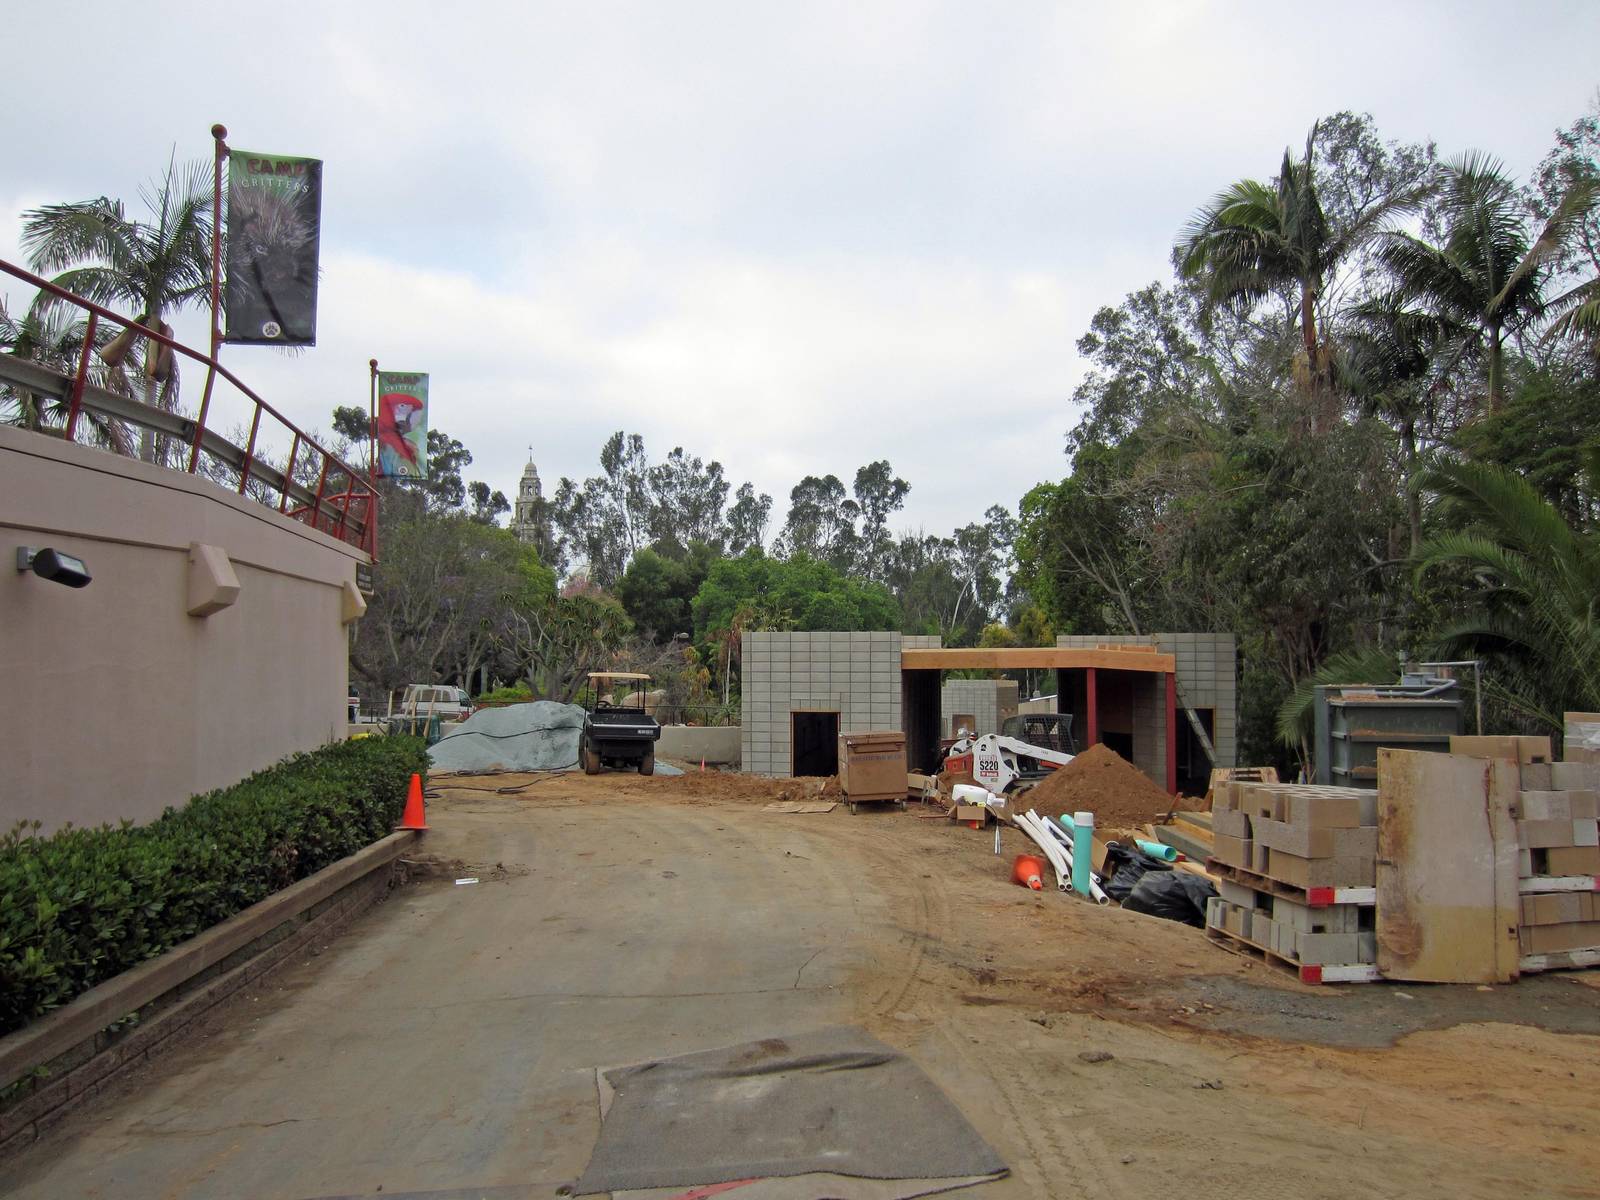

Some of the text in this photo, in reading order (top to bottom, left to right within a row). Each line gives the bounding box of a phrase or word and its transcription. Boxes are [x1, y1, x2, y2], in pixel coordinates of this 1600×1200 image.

[247, 158, 306, 177] CAMP
[241, 178, 309, 193] CRITTERS
[979, 760, 999, 771] S220
